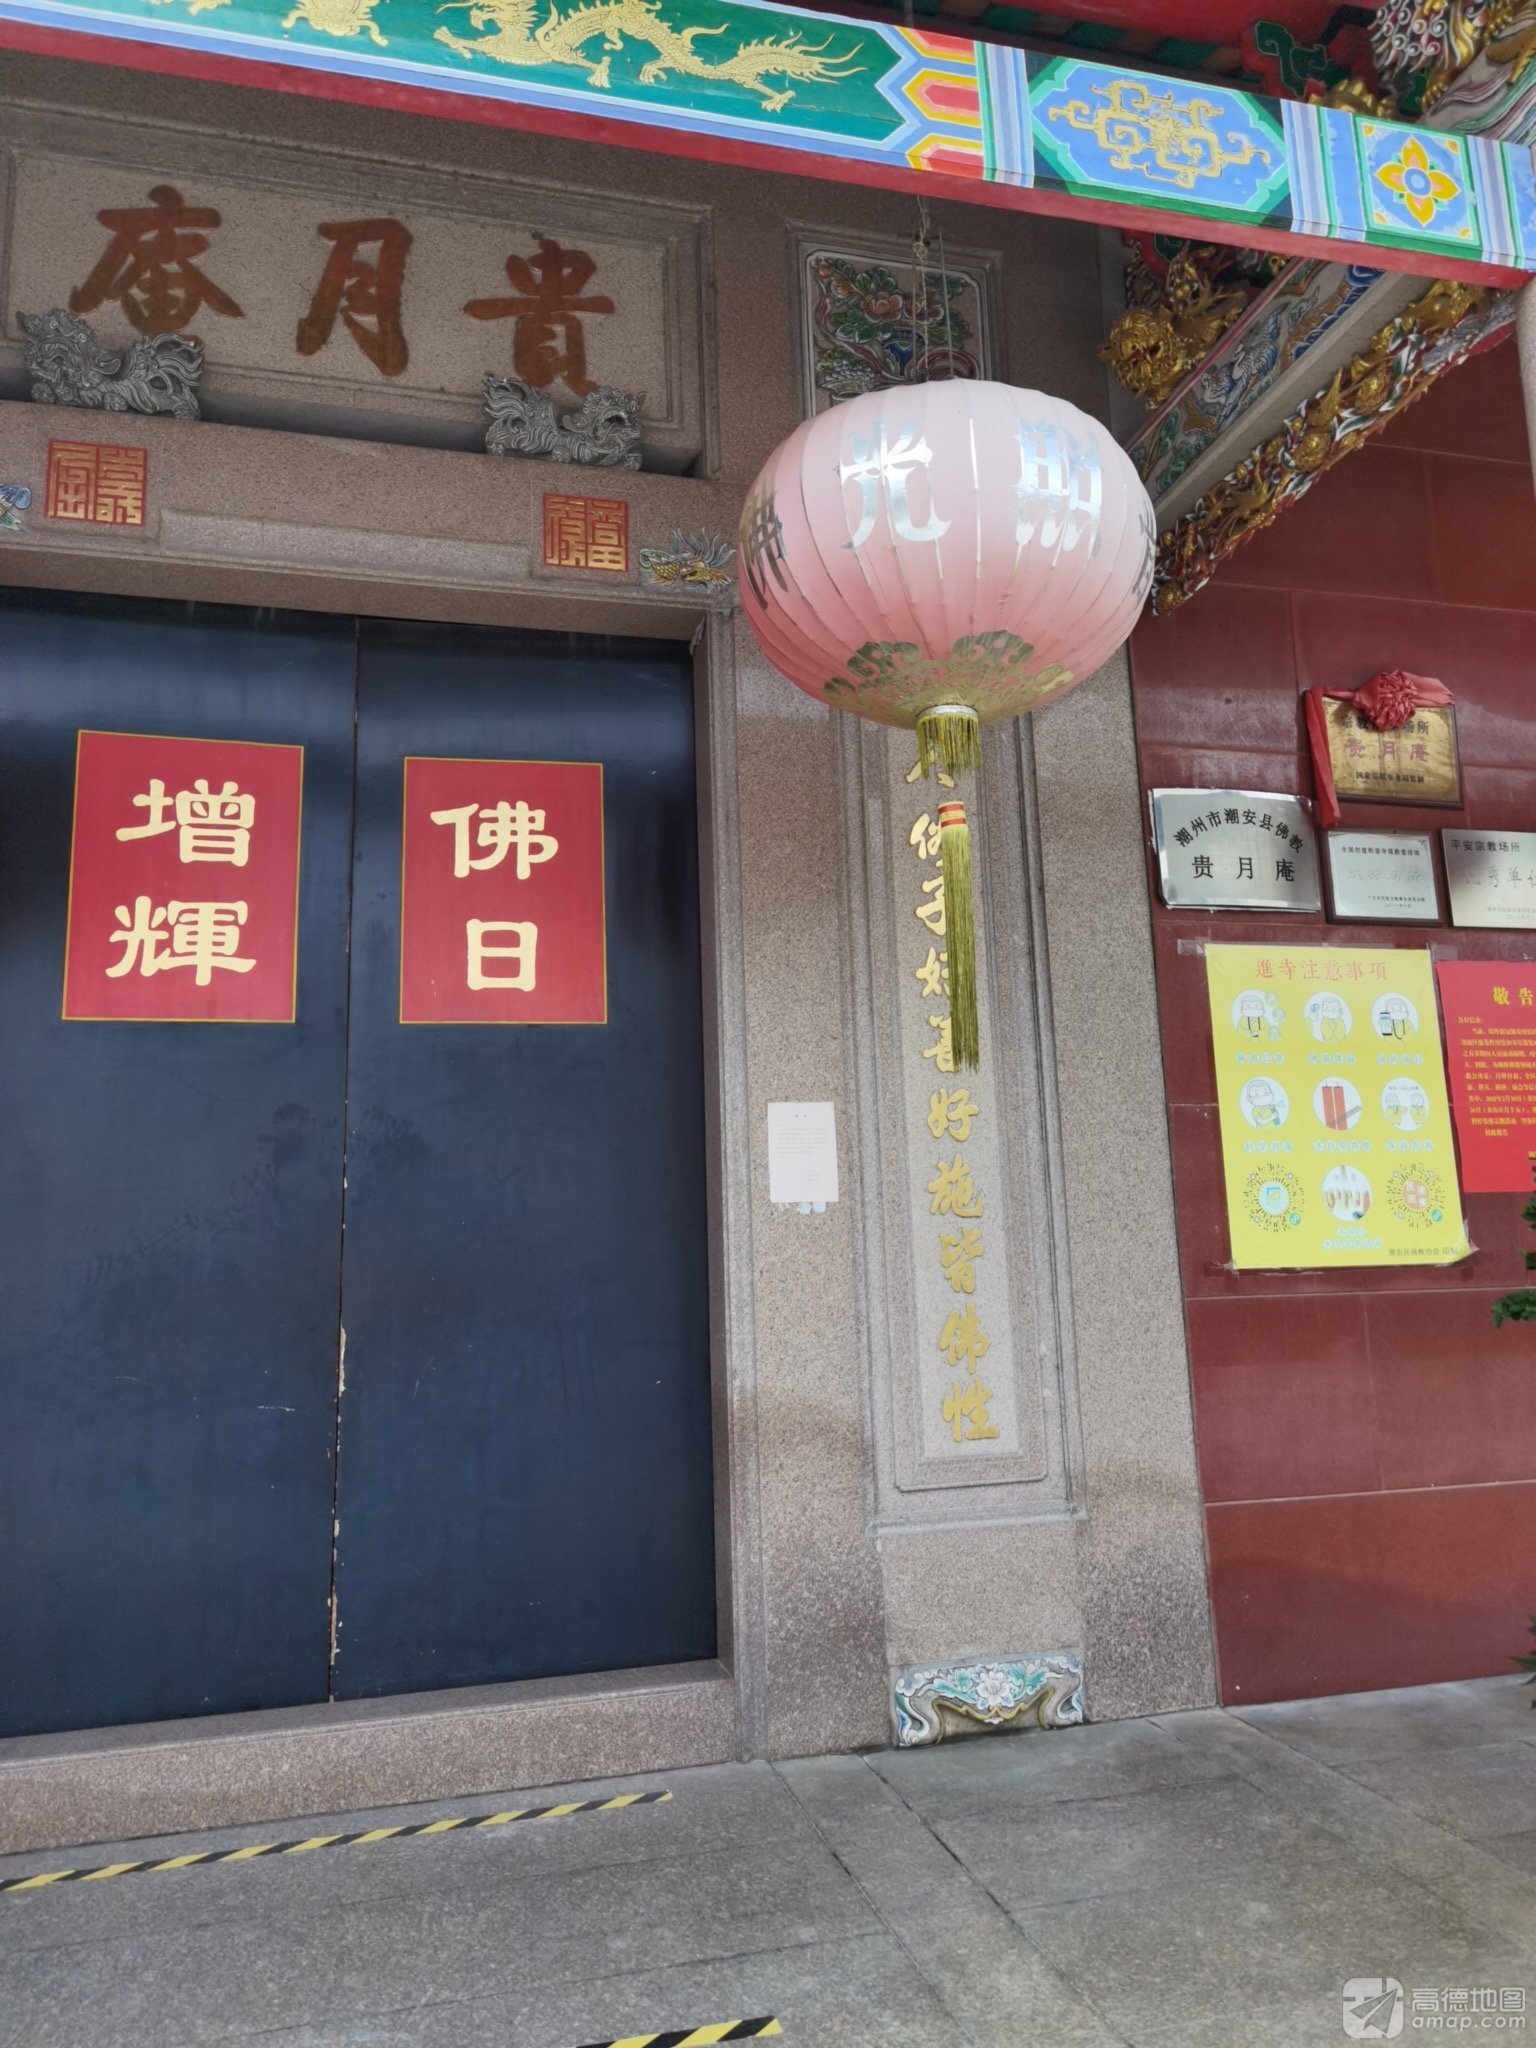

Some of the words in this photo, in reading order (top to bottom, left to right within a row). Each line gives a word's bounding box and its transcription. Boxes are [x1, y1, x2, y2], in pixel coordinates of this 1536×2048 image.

[1345, 738, 1428, 761] 贵月庵
[1173, 808, 1304, 853] 潮州市潮安县佛教
[1451, 839, 1520, 852] 平安宗教场所
[105, 778, 257, 986] 增輝
[1191, 854, 1295, 882] 贵月庵
[430, 800, 559, 992] 佛日
[1256, 958, 1388, 981] 進寺注意事項
